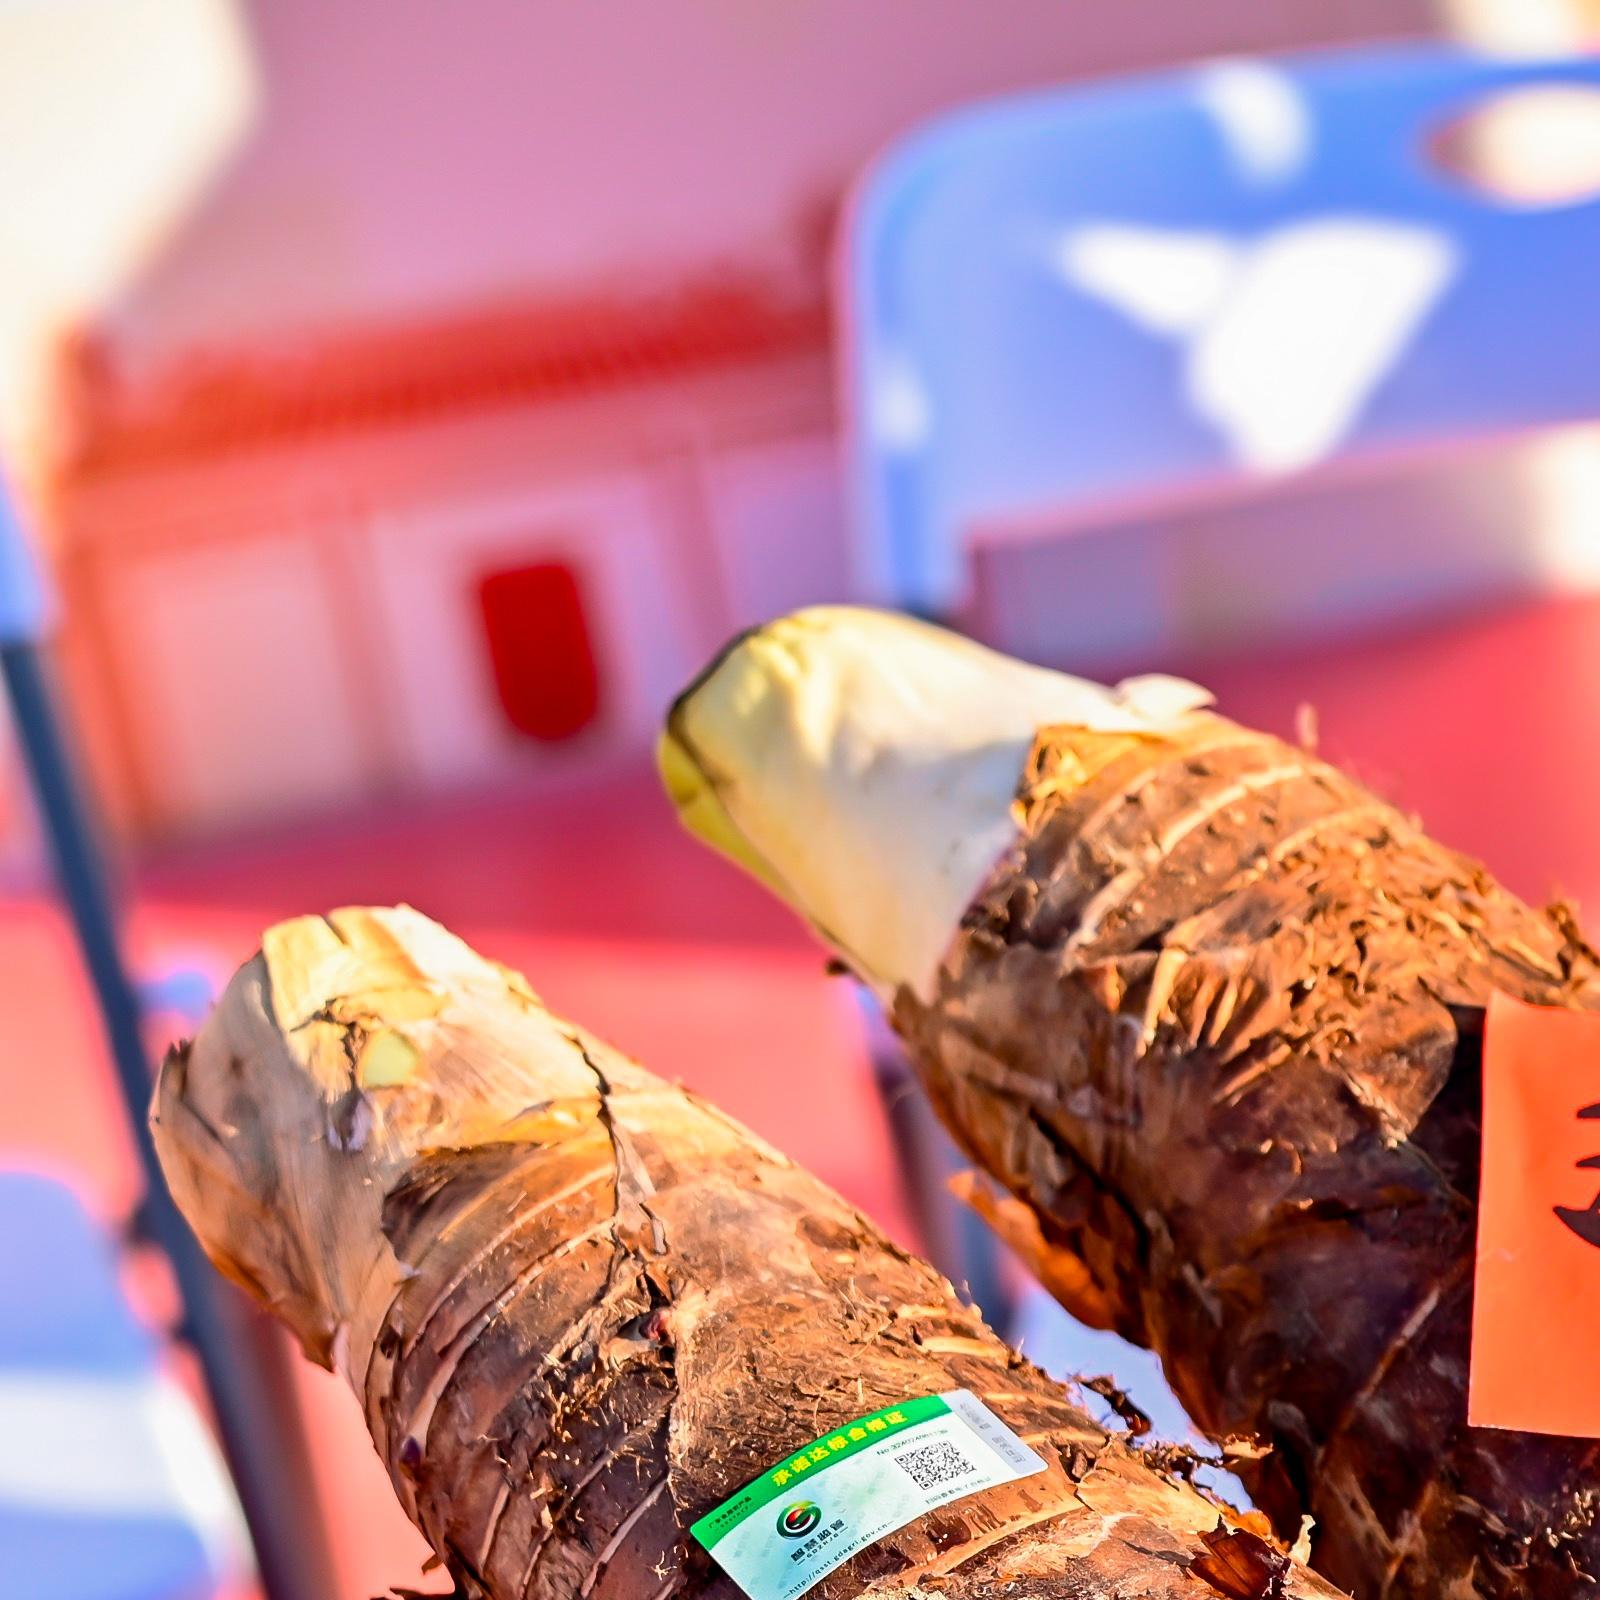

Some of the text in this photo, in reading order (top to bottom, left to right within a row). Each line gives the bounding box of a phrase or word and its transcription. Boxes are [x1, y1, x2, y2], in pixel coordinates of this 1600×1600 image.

[771, 1410, 907, 1488] 承诺达标合格证
[790, 1518, 847, 1562] 智慧监管
